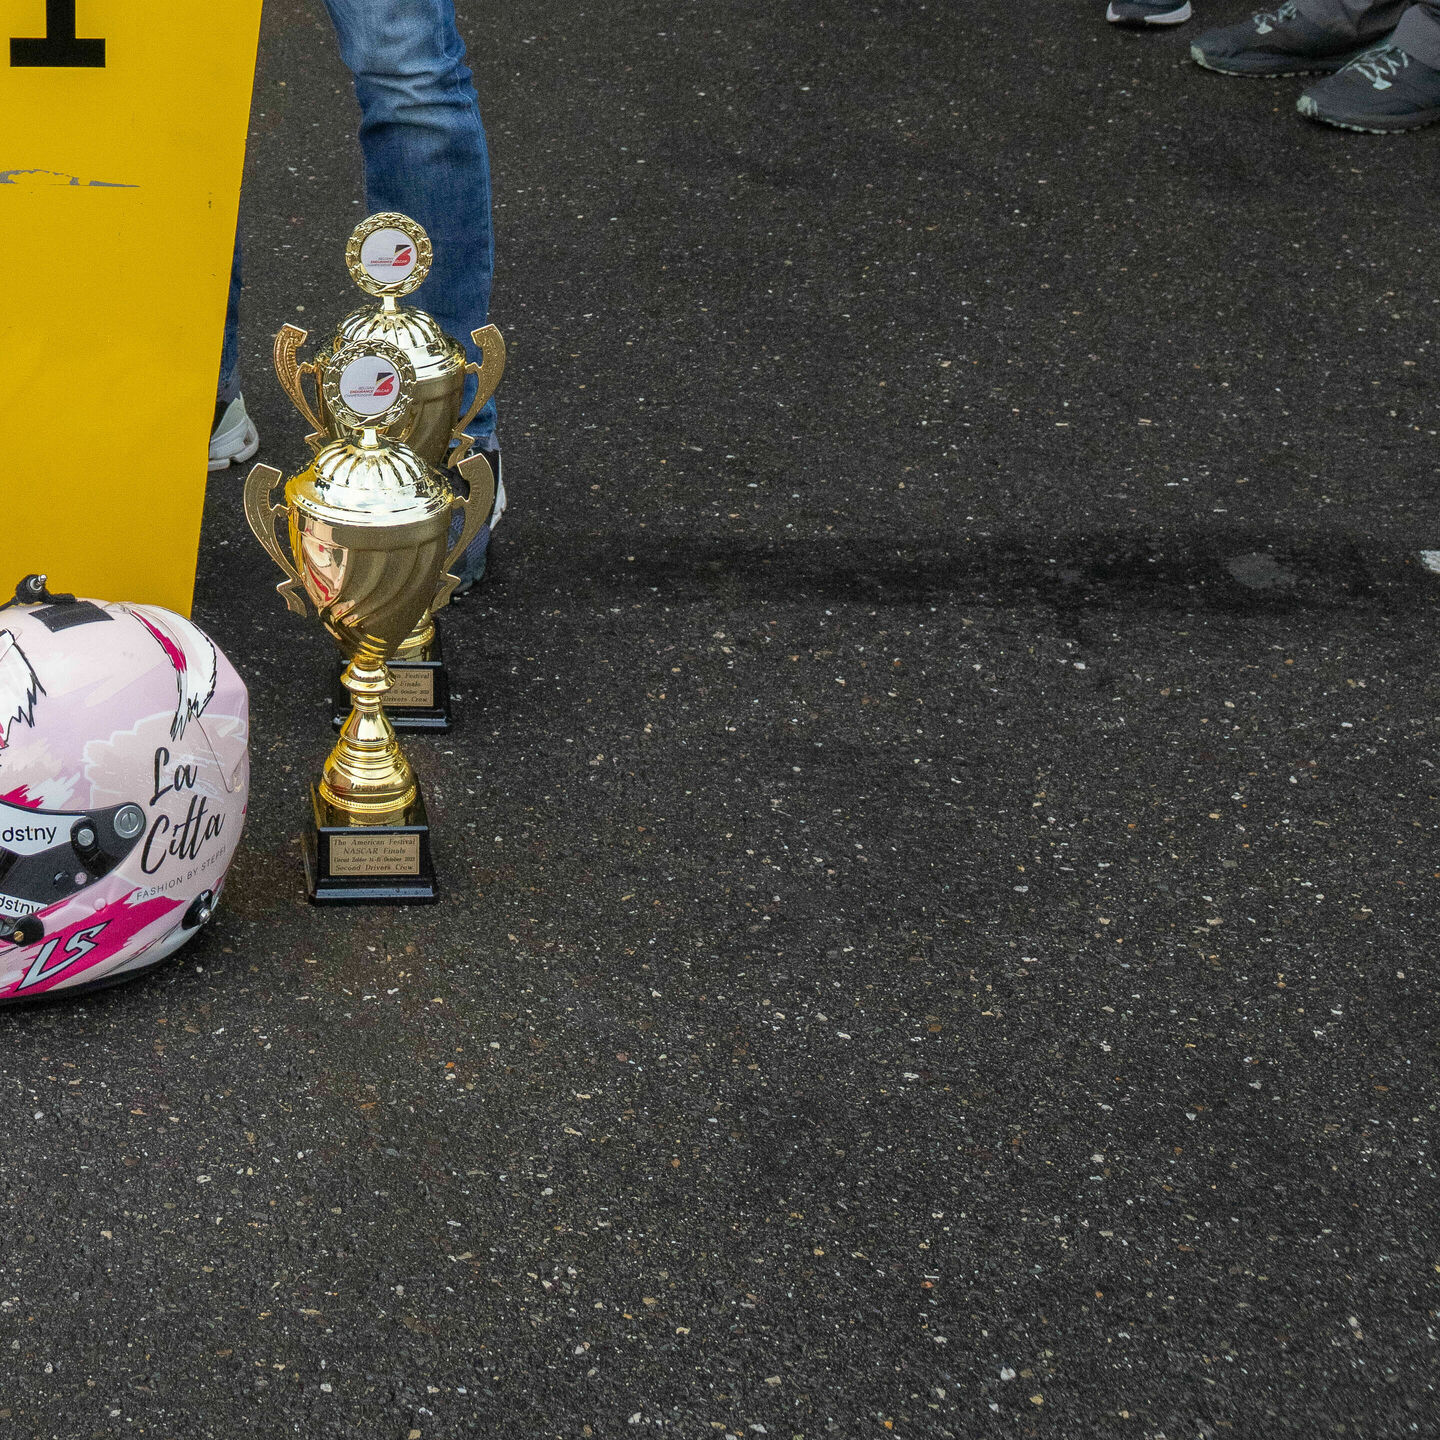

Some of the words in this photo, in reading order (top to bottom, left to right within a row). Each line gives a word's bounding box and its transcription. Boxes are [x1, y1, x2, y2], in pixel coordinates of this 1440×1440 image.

[149, 746, 199, 807] La
[1, 825, 58, 845] dstny
[140, 794, 227, 875] Citta
[343, 847, 379, 855] NASCAR
[135, 874, 184, 902] FASHION
[186, 866, 200, 881] BY
